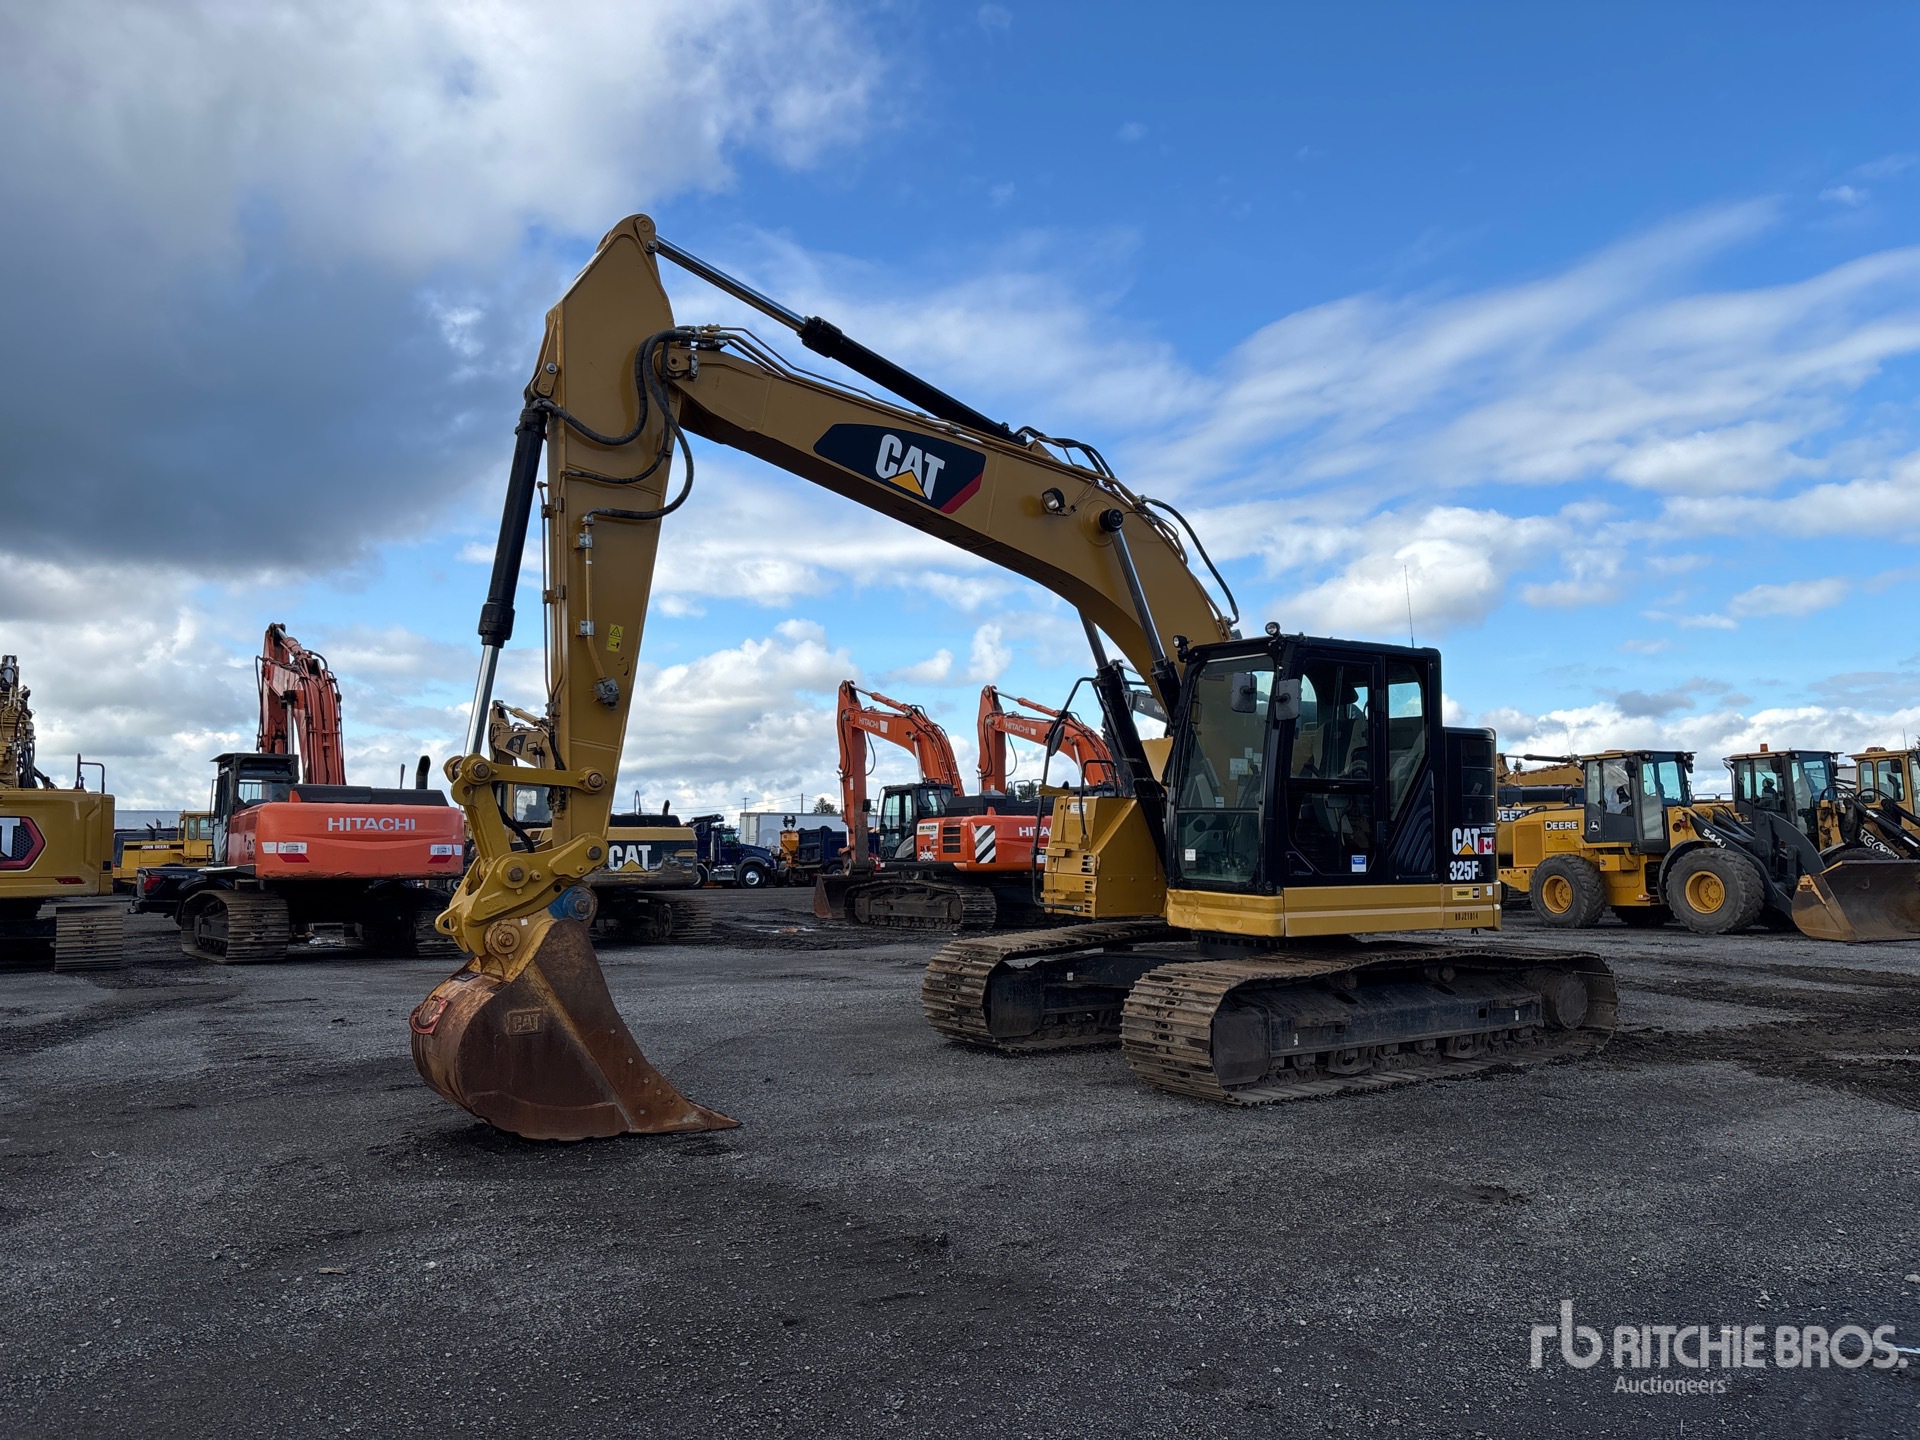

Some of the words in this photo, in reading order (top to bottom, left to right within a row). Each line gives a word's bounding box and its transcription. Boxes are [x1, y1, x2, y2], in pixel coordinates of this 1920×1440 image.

[875, 433, 946, 501] CAT
[858, 716, 880, 729] HITACHI
[1004, 721, 1030, 734] HITACHI
[327, 816, 416, 832] HITACHI
[1545, 821, 1578, 831] DEERE
[1452, 827, 1480, 855] CAT
[1702, 828, 1727, 849] 544J
[608, 844, 652, 872] CAT
[512, 1013, 541, 1033] CAT
